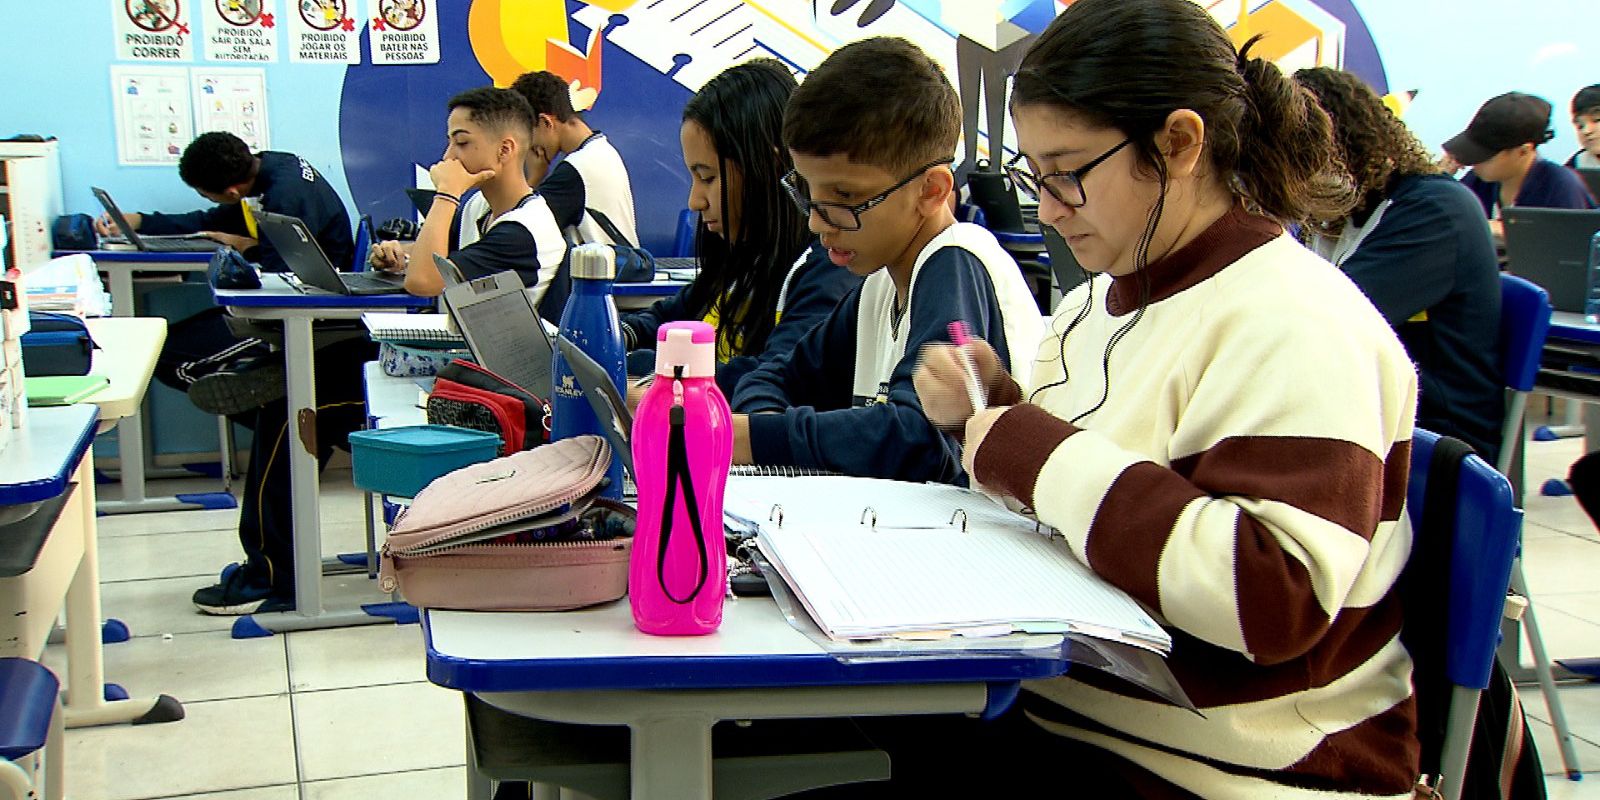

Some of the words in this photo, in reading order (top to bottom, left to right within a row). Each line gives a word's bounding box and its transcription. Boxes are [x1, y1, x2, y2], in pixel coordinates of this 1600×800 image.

[218, 28, 262, 37] PROIBIDO
[126, 33, 184, 46] PROIBIDO
[212, 37, 232, 45] SAIR
[234, 37, 247, 45] DA
[249, 38, 271, 46] SALA
[301, 33, 346, 42] PROIBIDO
[382, 33, 426, 42] PROIBIDO
[300, 42, 331, 51] JOGAR
[333, 43, 346, 51] OS
[380, 43, 408, 52] BATER
[410, 42, 429, 51] NAS
[133, 47, 181, 58] CORRER
[299, 51, 348, 60] MATERIAIS
[385, 52, 425, 60] PESSOAS
